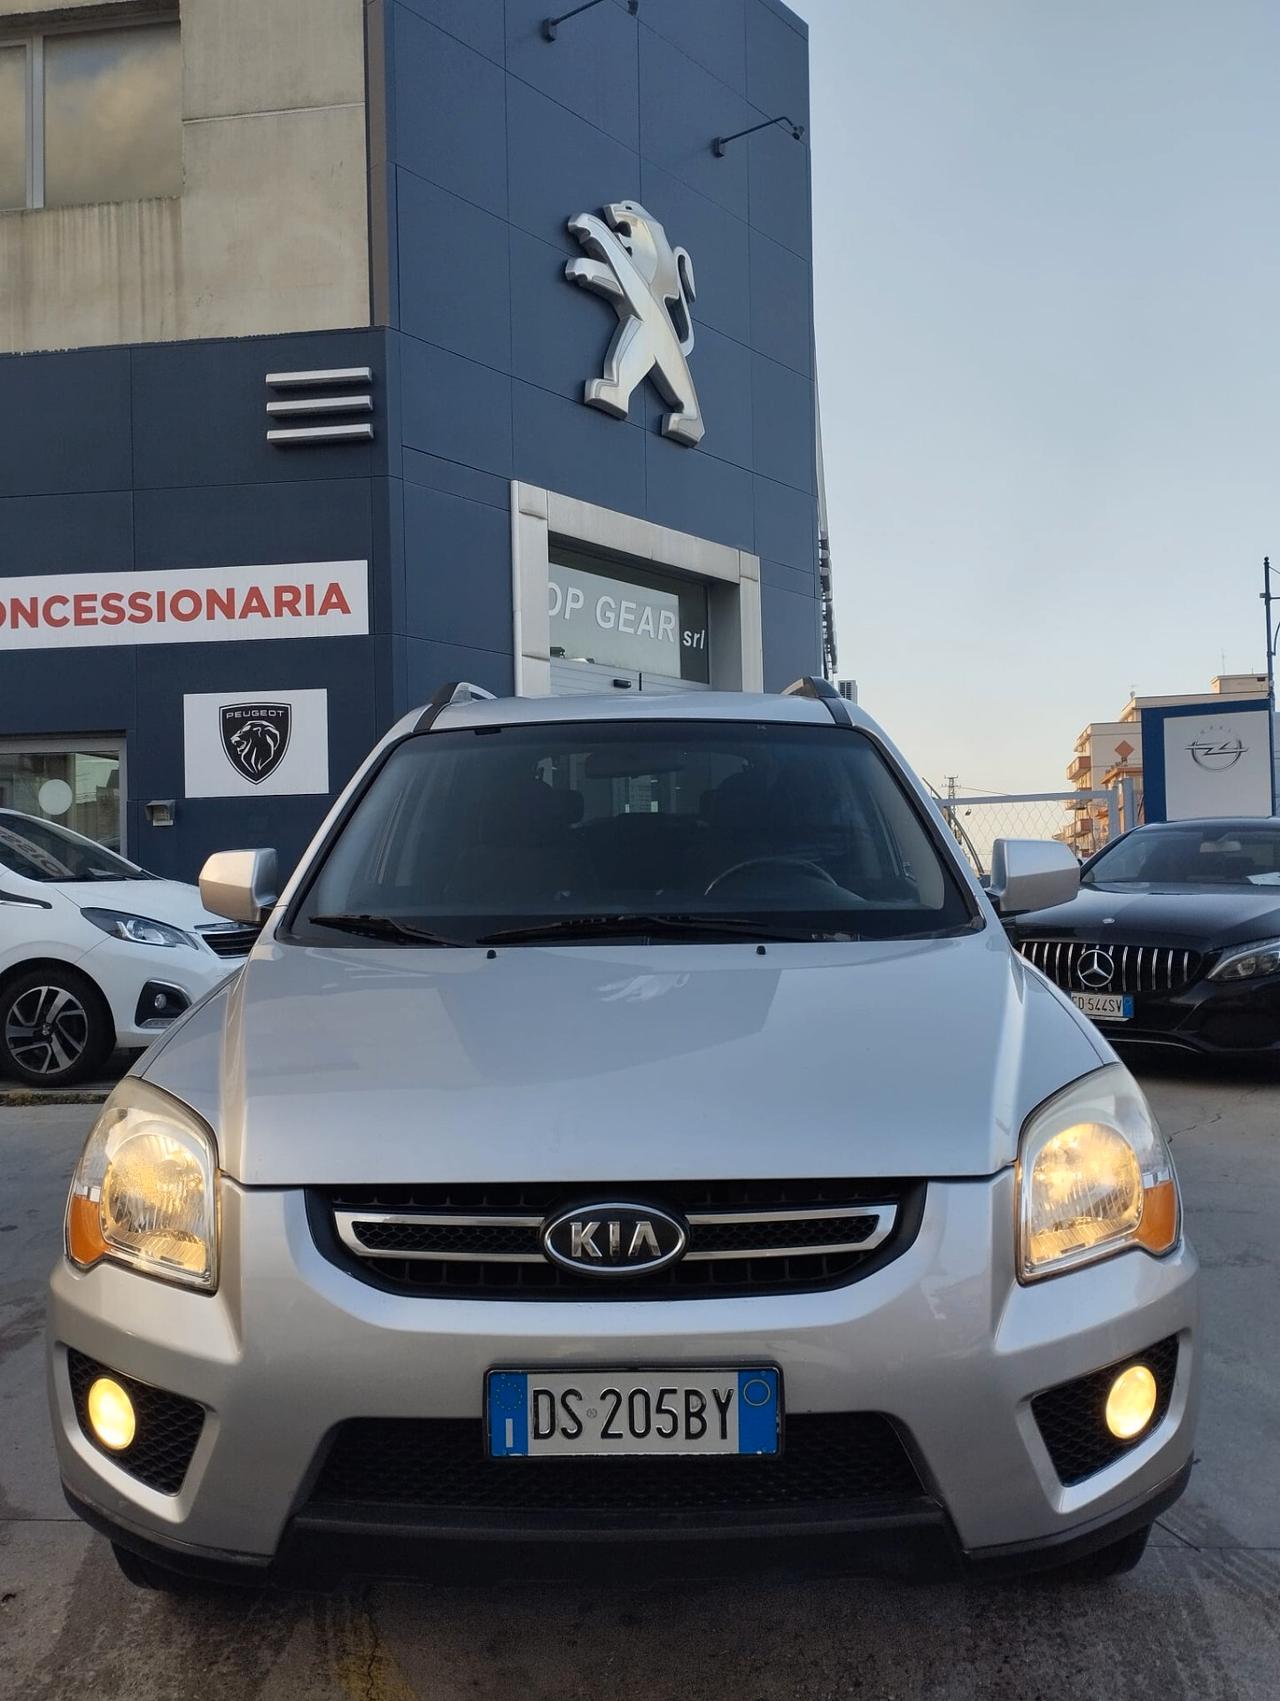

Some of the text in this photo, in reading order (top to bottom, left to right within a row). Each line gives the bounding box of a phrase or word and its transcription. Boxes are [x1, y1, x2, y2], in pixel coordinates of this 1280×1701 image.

[0, 582, 352, 629] NCESSIONARIA
[595, 596, 677, 642] GEAR
[682, 629, 705, 649] srl
[226, 709, 285, 719] PEUGEOT
[570, 1221, 662, 1257] KIA
[532, 1388, 583, 1440] DS
[600, 1387, 735, 1440] 205BY
